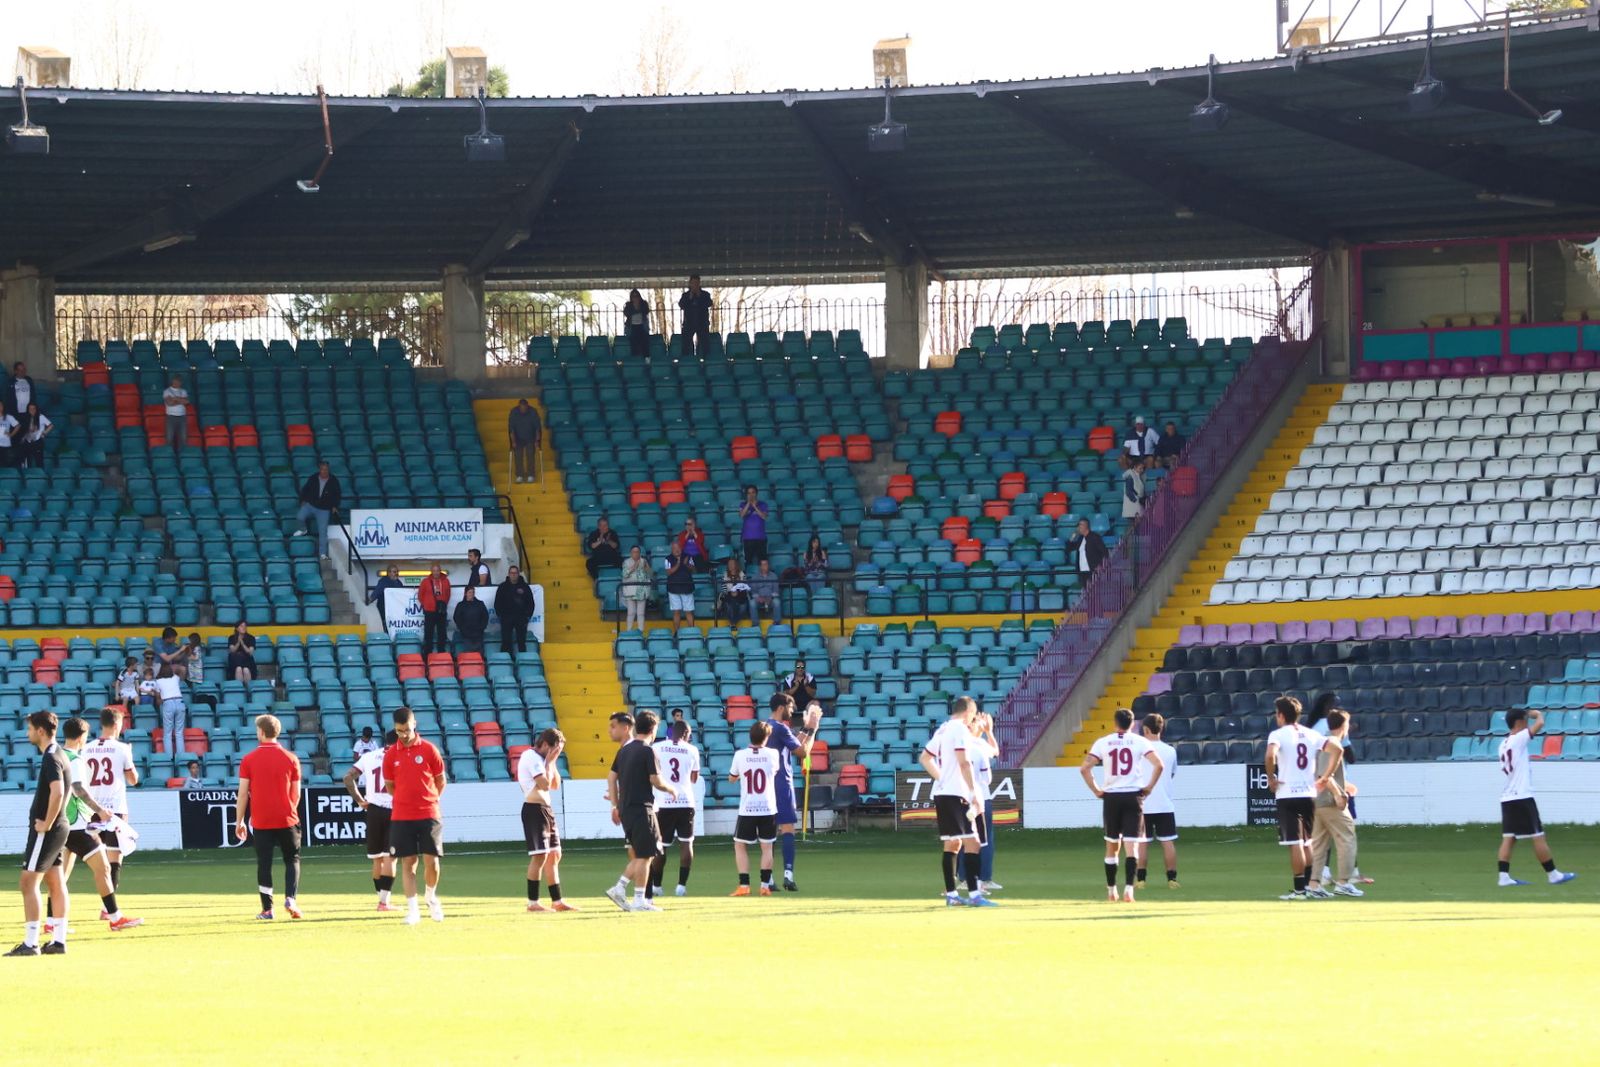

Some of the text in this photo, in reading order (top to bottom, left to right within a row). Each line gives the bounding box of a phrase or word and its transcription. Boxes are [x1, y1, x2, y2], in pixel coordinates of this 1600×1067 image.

[394, 521, 480, 533] MINIMARKET
[404, 534, 439, 542] MIRANDA
[1108, 747, 1133, 776] 19
[1296, 743, 1308, 770] 8
[86, 757, 114, 787] 23
[669, 757, 680, 783] 3
[744, 768, 767, 795] 10
[313, 822, 367, 840] CHAR
